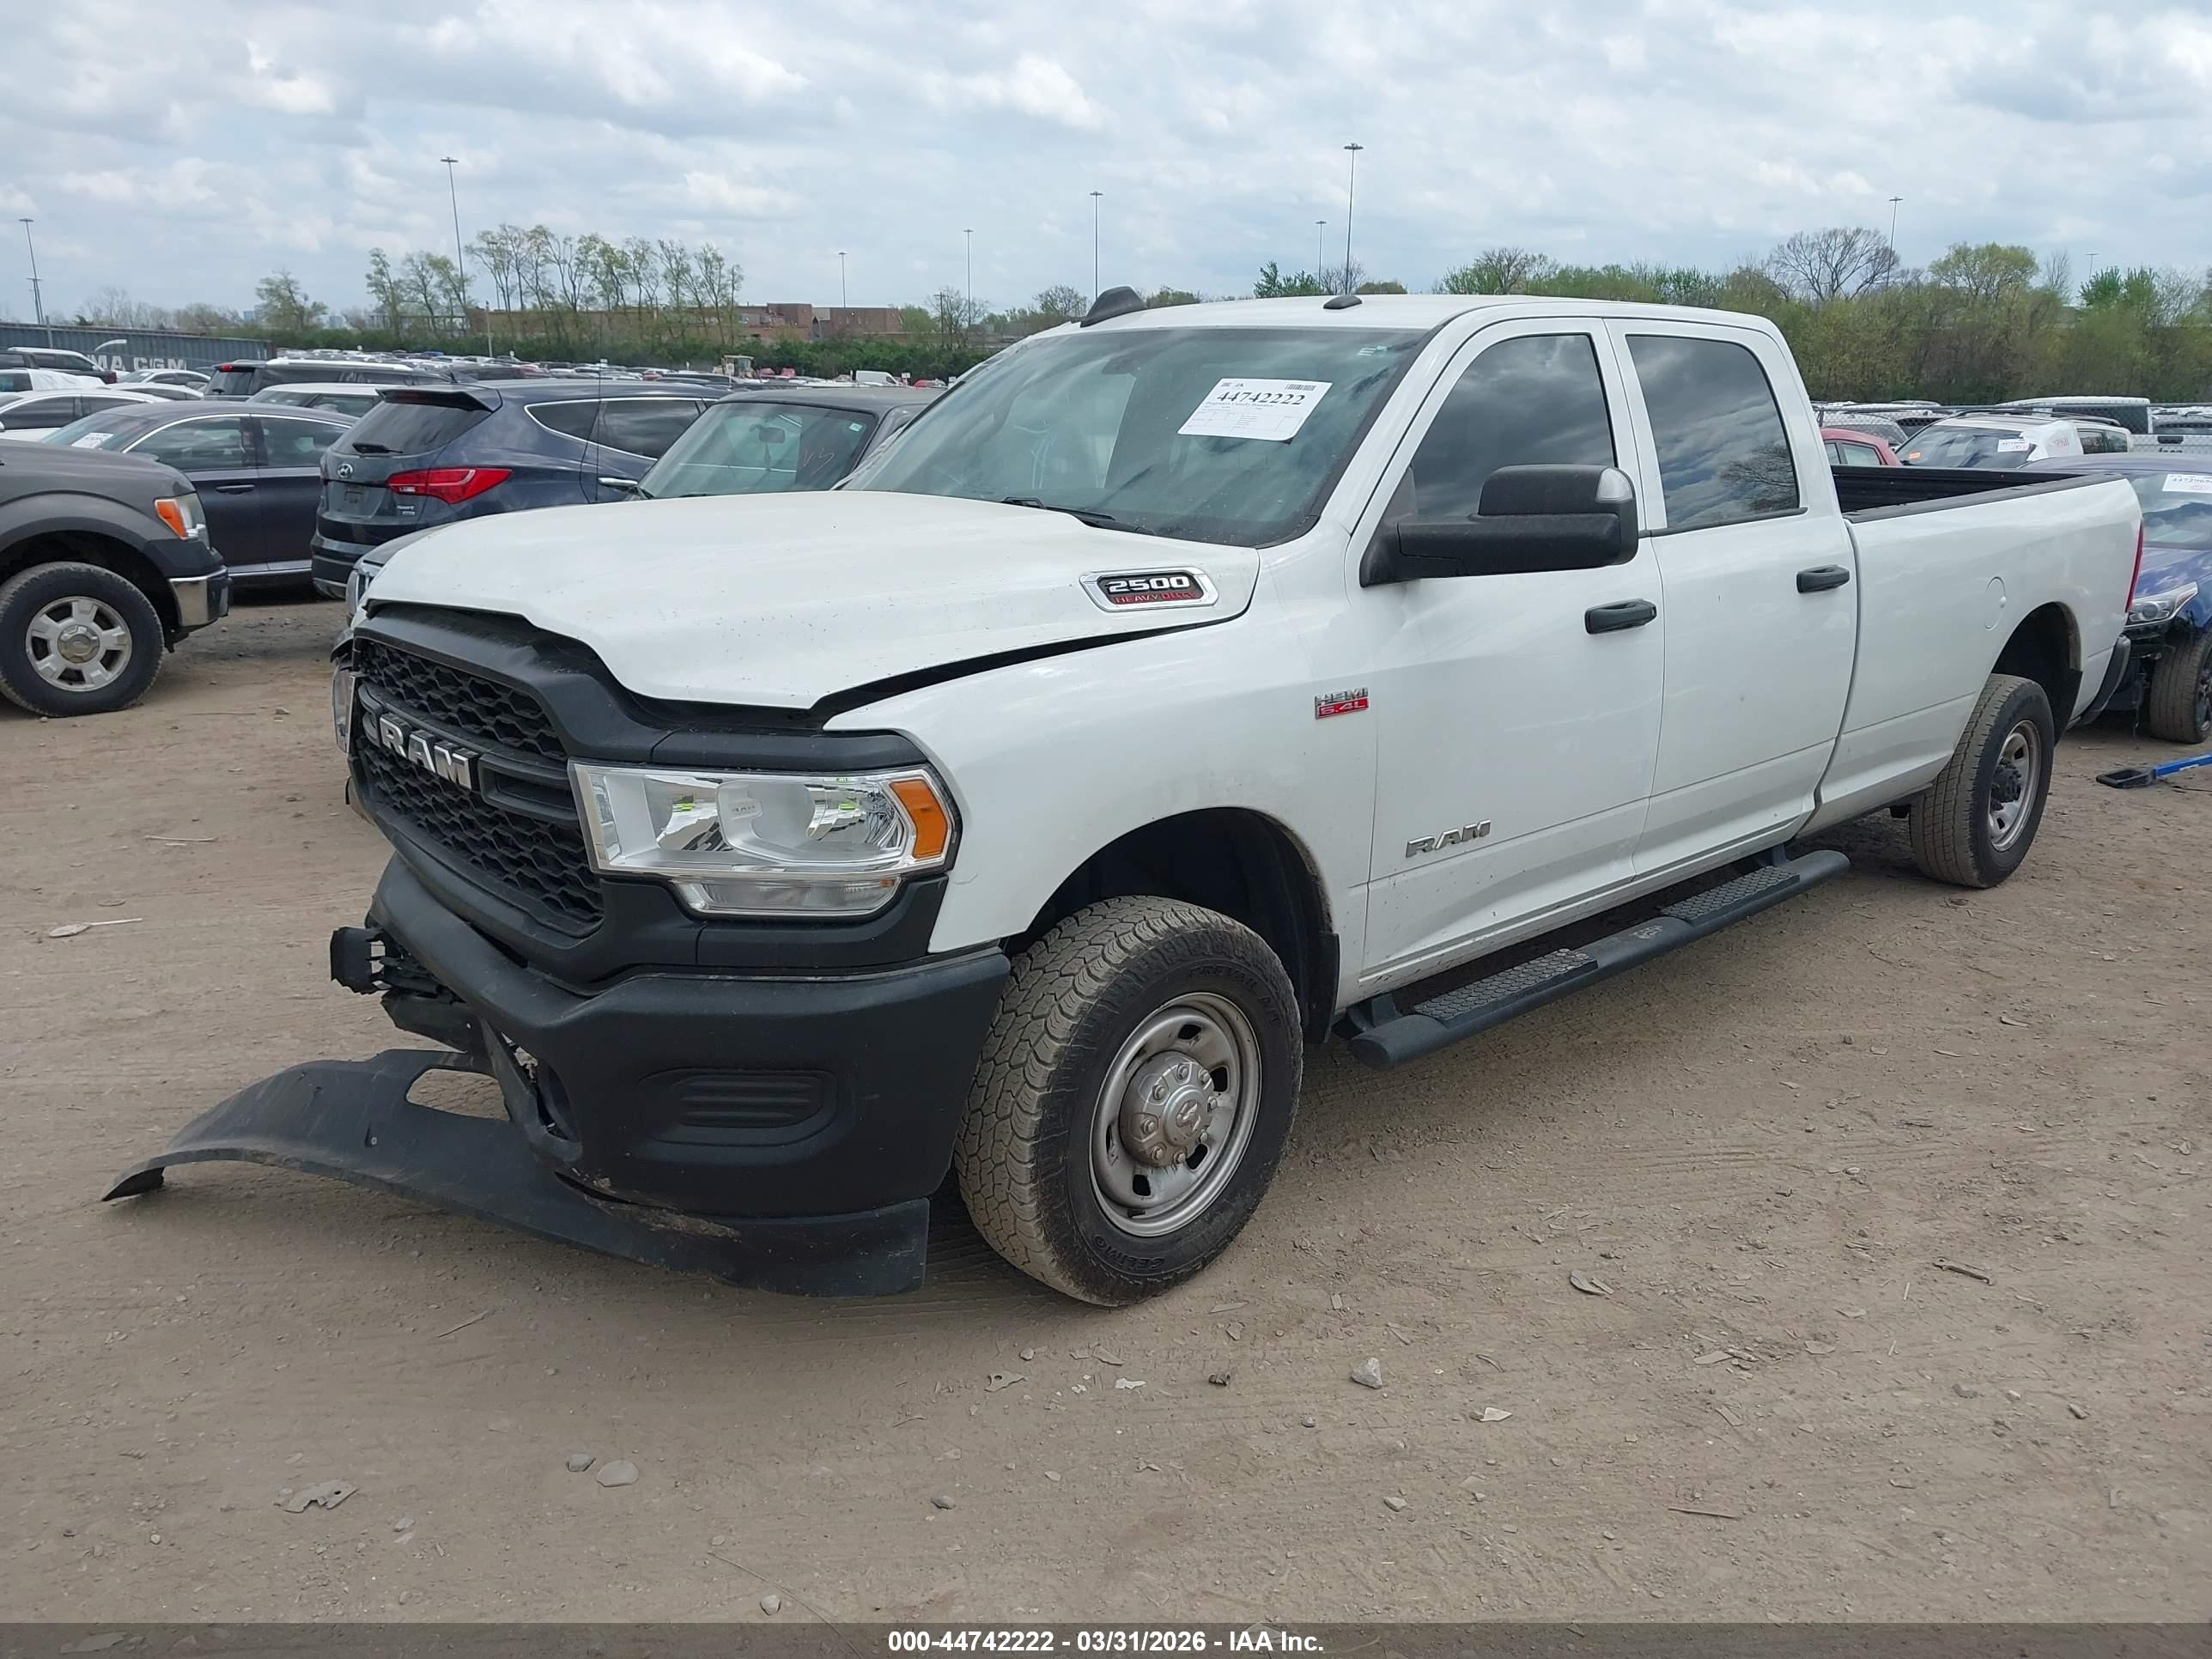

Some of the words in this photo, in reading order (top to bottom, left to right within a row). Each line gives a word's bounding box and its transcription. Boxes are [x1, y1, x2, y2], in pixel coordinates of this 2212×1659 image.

[87, 354, 126, 371] MA
[1217, 392, 1305, 404] 44742222
[1108, 575, 1190, 593] 2500
[1113, 593, 1158, 604] HEAVY
[1162, 591, 1196, 600] DUTY
[1320, 700, 1368, 715] 6.4L
[380, 714, 473, 790] RAM
[1405, 819, 1492, 858] RAM
